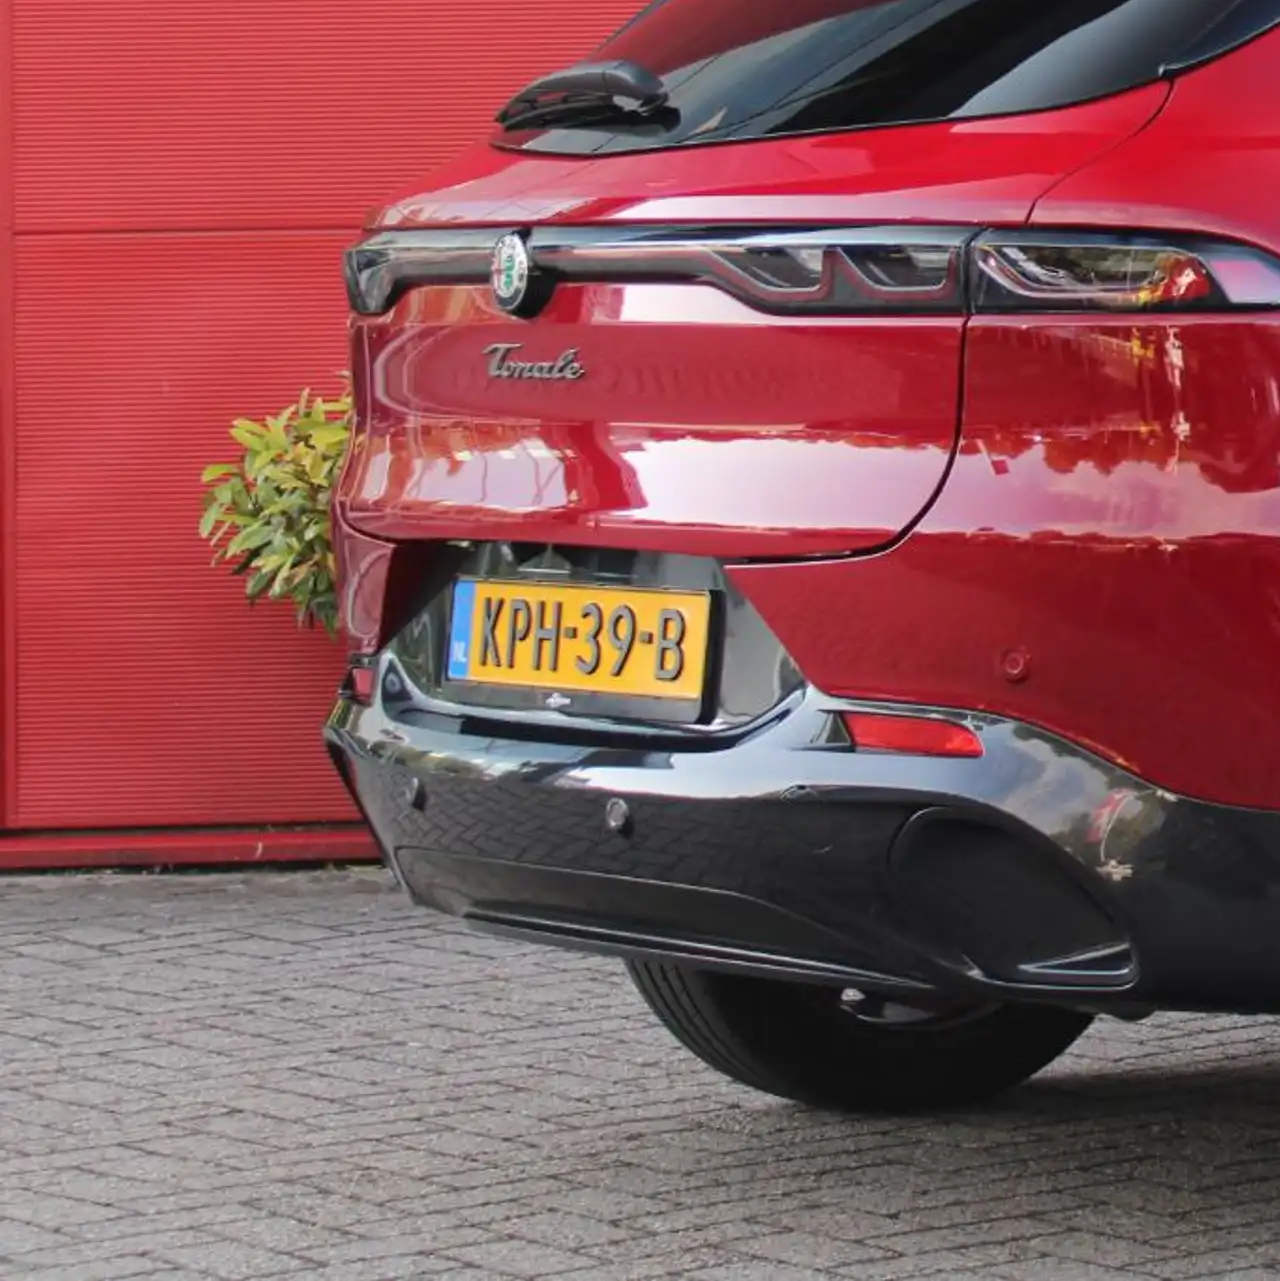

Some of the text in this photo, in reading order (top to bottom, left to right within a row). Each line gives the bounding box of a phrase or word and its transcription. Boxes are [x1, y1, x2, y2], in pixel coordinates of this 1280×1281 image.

[482, 343, 585, 380] Tonale
[453, 639, 468, 663] NL
[479, 596, 687, 681] KPH-39-B
